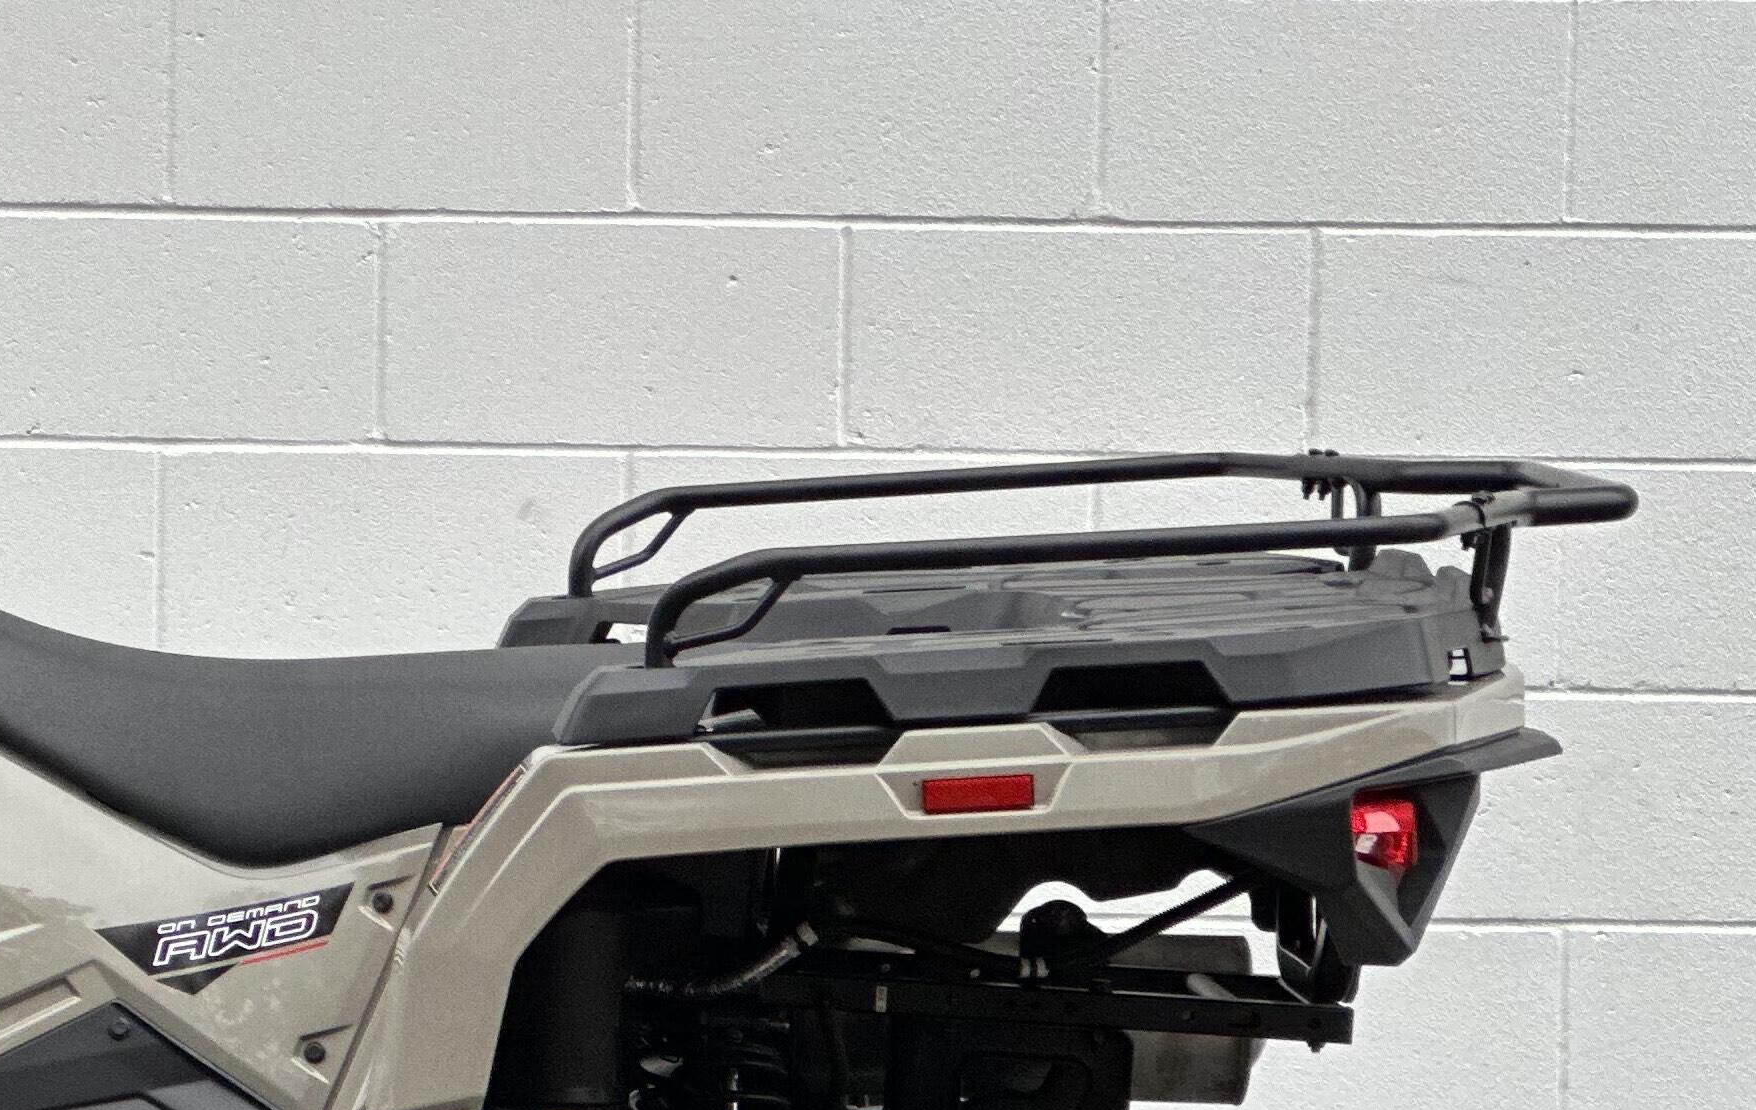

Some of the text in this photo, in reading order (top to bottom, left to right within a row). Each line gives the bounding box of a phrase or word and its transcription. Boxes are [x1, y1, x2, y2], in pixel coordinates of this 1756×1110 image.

[152, 909, 319, 966] AWD
[157, 895, 320, 935] ON DEMAND
